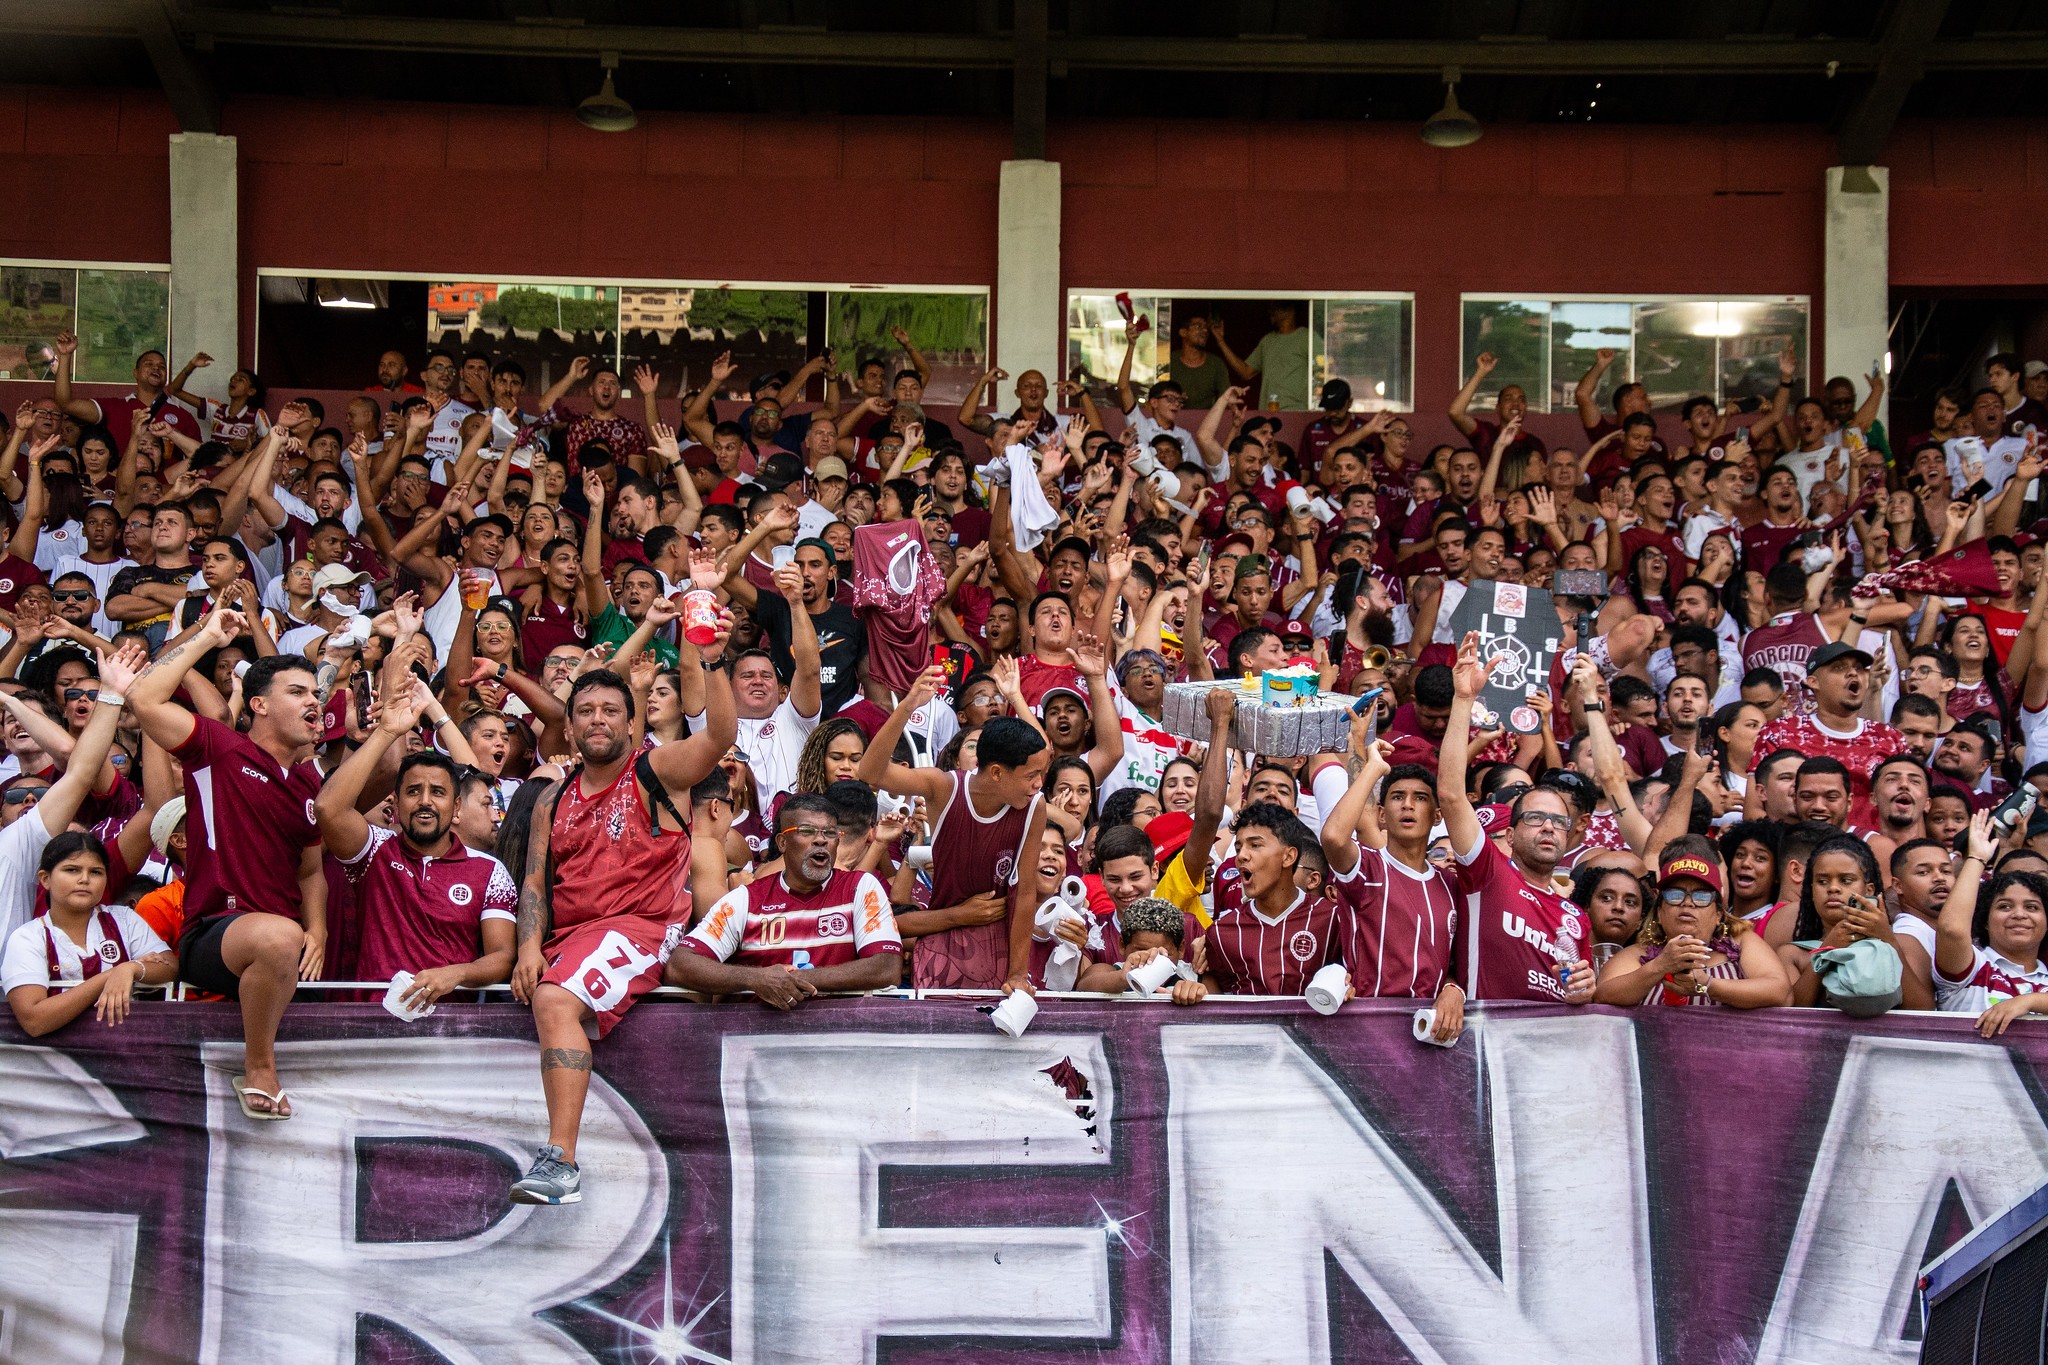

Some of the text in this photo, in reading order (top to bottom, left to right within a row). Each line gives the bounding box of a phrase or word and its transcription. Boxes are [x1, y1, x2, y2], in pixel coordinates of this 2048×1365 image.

[1504, 617, 1517, 633] B
[1673, 859, 1706, 873] BRAVO
[760, 917, 786, 946] 10
